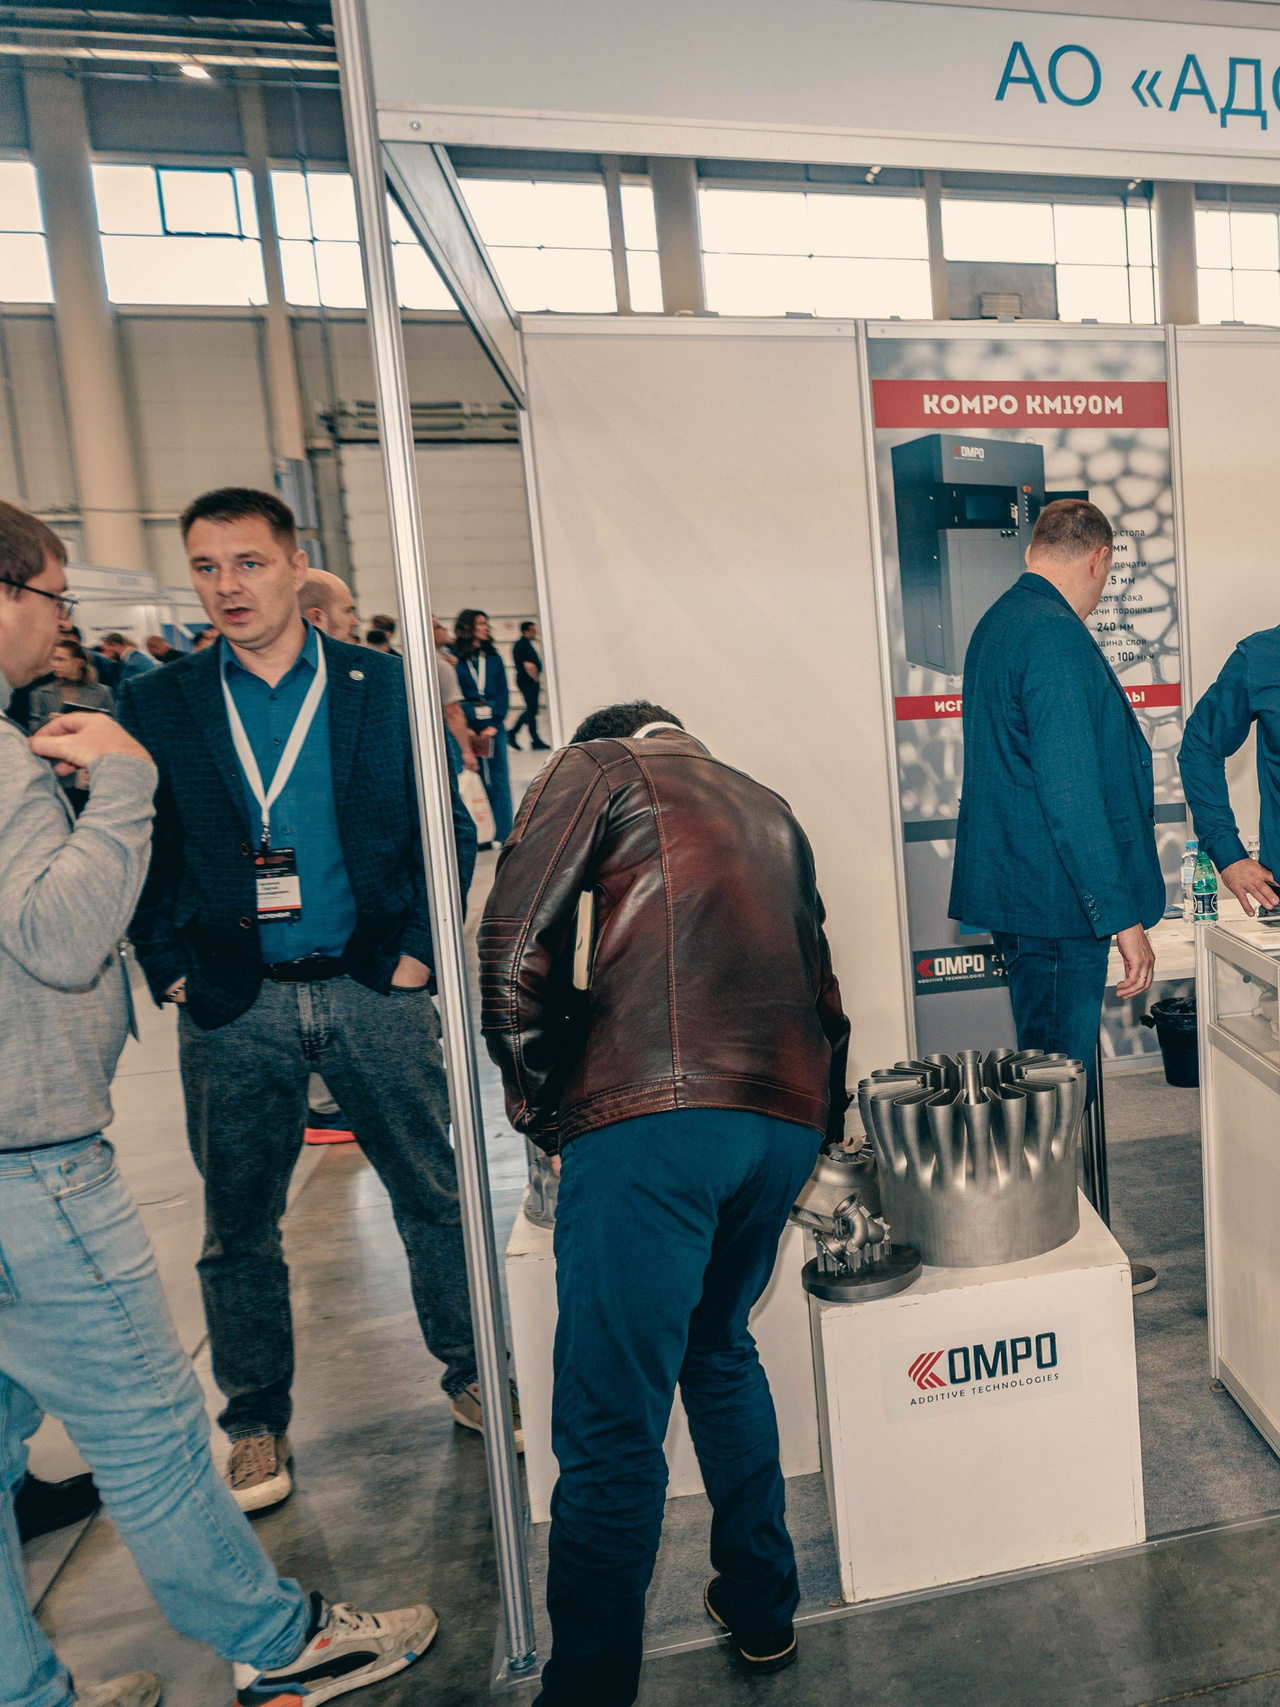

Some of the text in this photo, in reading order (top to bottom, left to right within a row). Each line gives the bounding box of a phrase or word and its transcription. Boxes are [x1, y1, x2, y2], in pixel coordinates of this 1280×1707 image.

[995, 41, 1102, 106] АО
[1119, 529, 1146, 537] стола
[1114, 561, 1147, 569] печати
[1120, 577, 1136, 585] мм
[1099, 594, 1143, 603] сота бака
[1112, 606, 1153, 616] порошка
[1096, 622, 1116, 632] 240
[1098, 640, 1123, 648] щина
[1117, 651, 1135, 662] 100
[910, 1372, 1060, 1406] ADDITIVE TECHNOLOGIES
